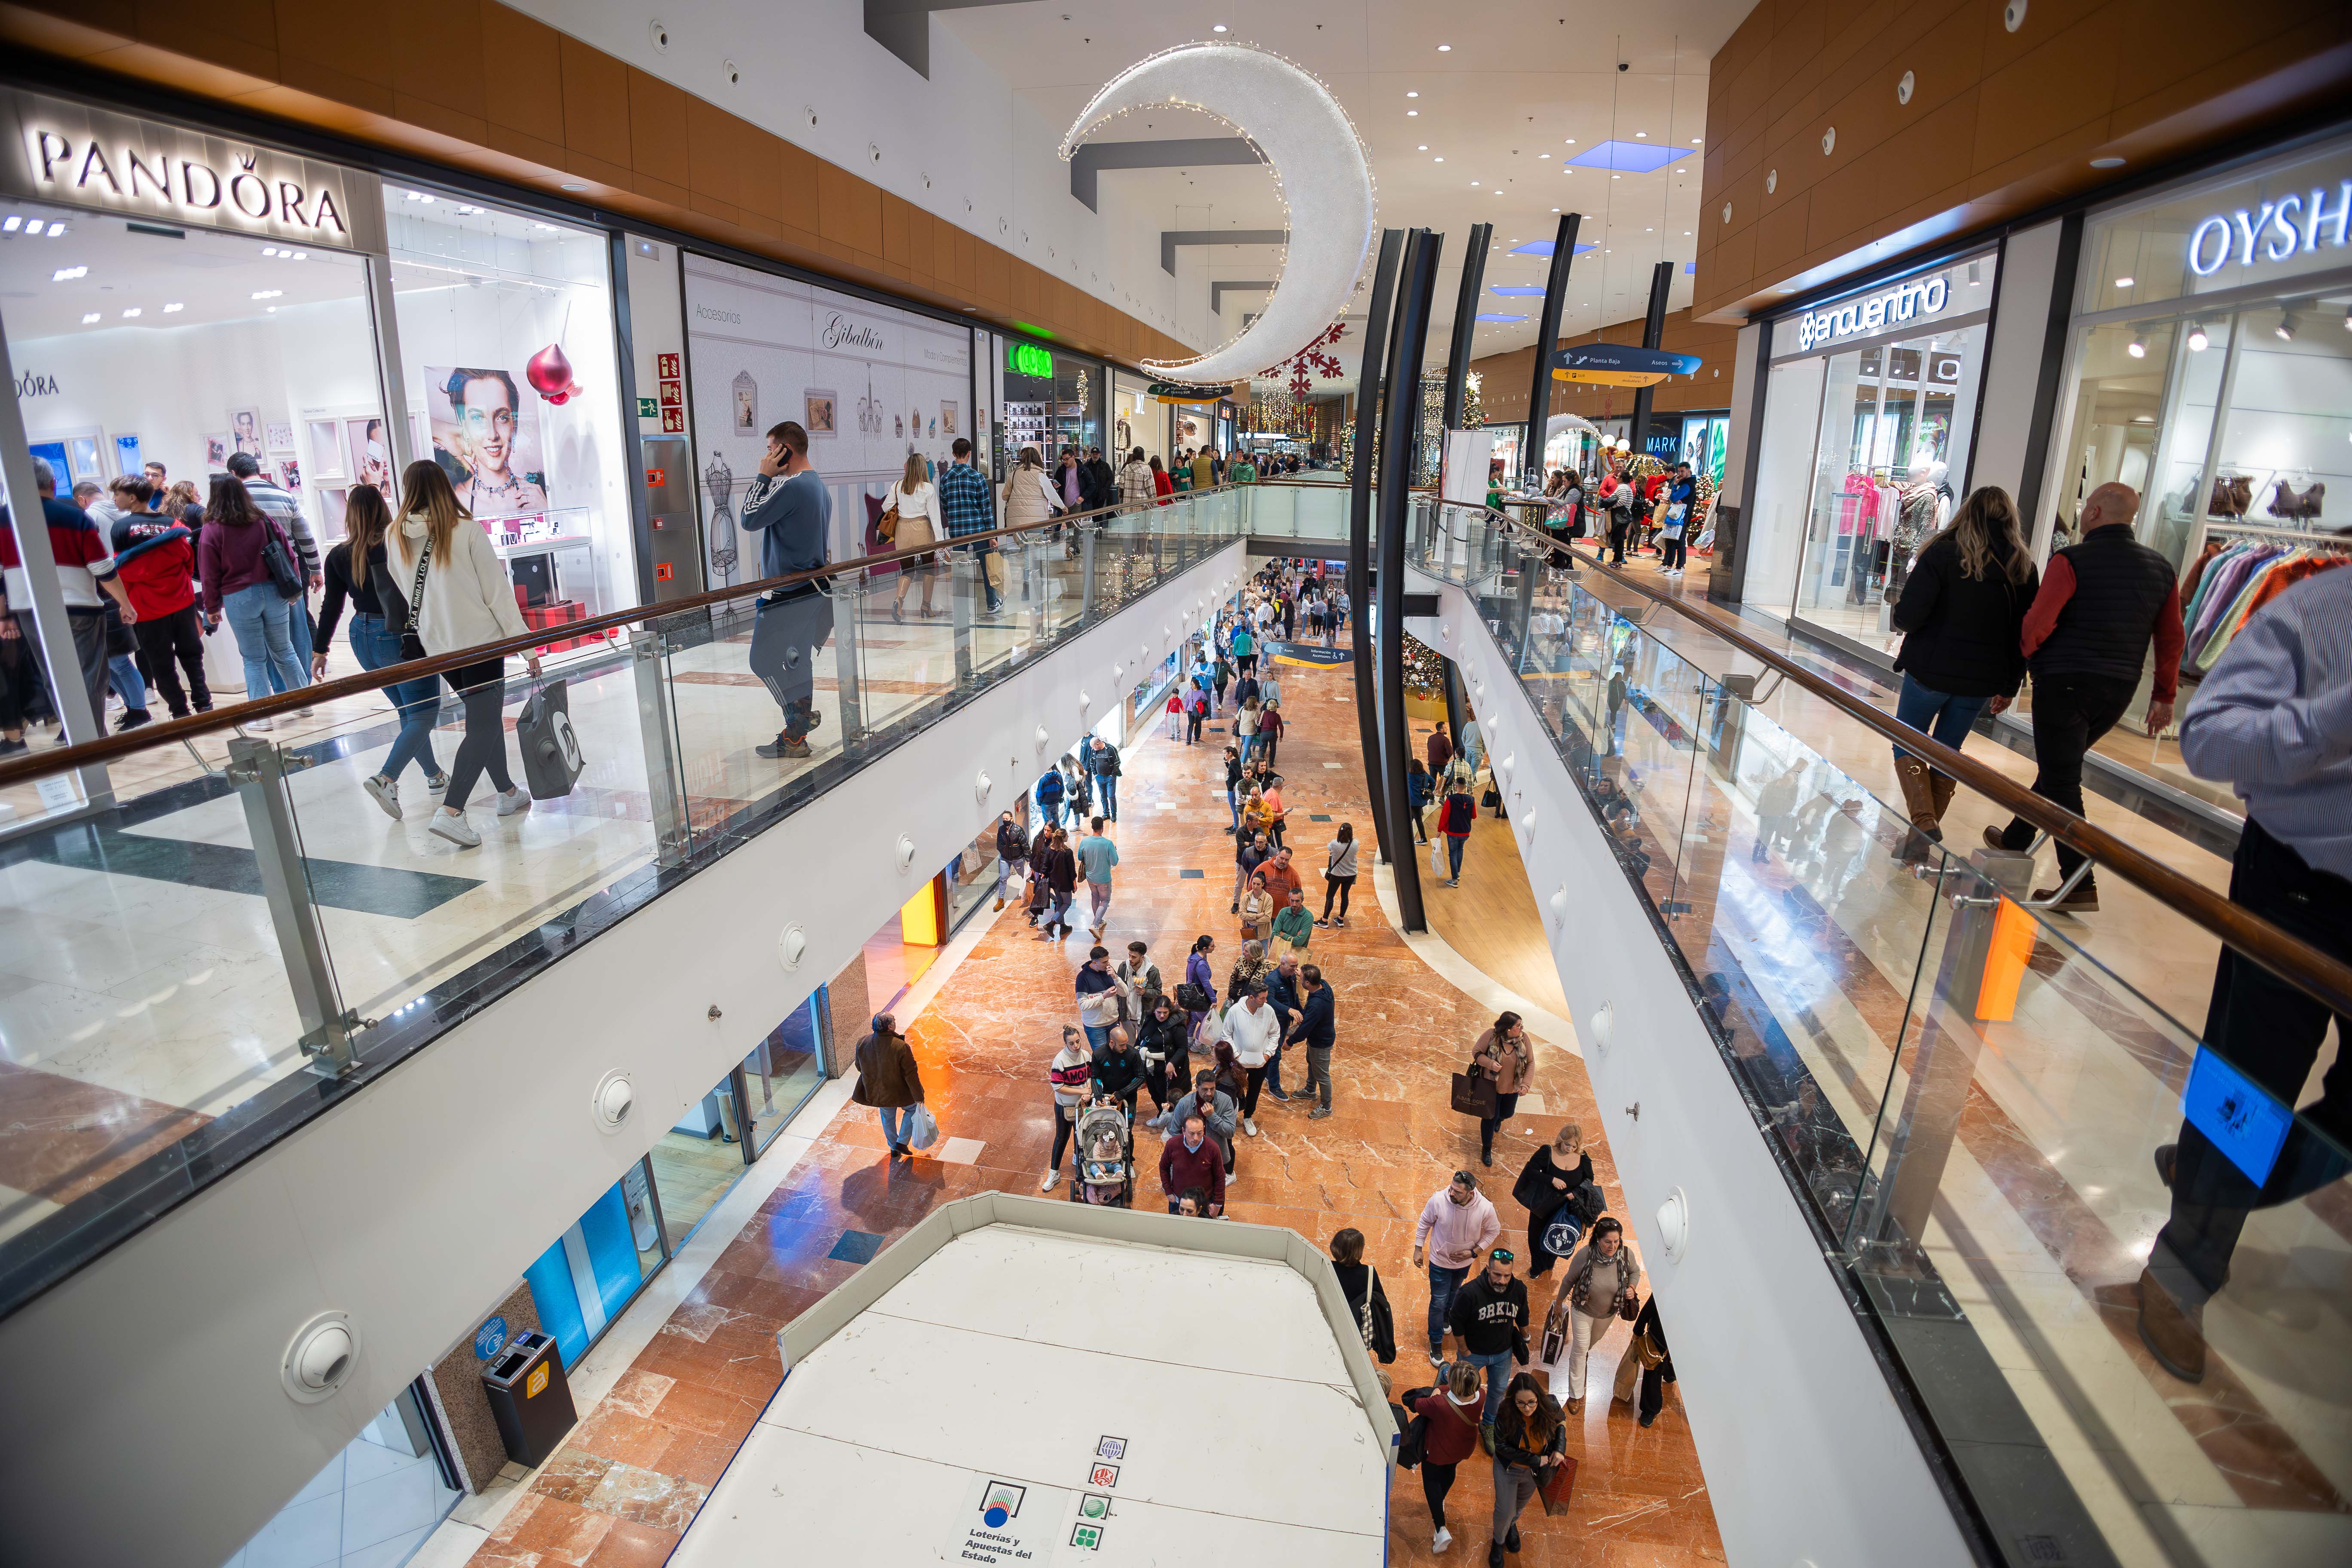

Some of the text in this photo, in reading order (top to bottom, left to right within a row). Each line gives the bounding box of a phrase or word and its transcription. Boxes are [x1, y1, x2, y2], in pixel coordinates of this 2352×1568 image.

[36, 130, 347, 234] PANDORA
[2189, 180, 2352, 277] OYSH
[696, 303, 741, 325] Accesorios
[1815, 278, 1949, 342] encuentro
[822, 311, 885, 351] Gibalbín
[924, 349, 936, 360] Moda
[940, 351, 967, 366] Complementos
[419, 556, 430, 576] LOLA
[560, 723, 575, 763] JD
[1478, 1301, 1519, 1320] BRKLN
[969, 1528, 1020, 1547] Loterías y
[961, 1550, 997, 1564] Estado
[965, 1540, 1032, 1559] Apuestas del
